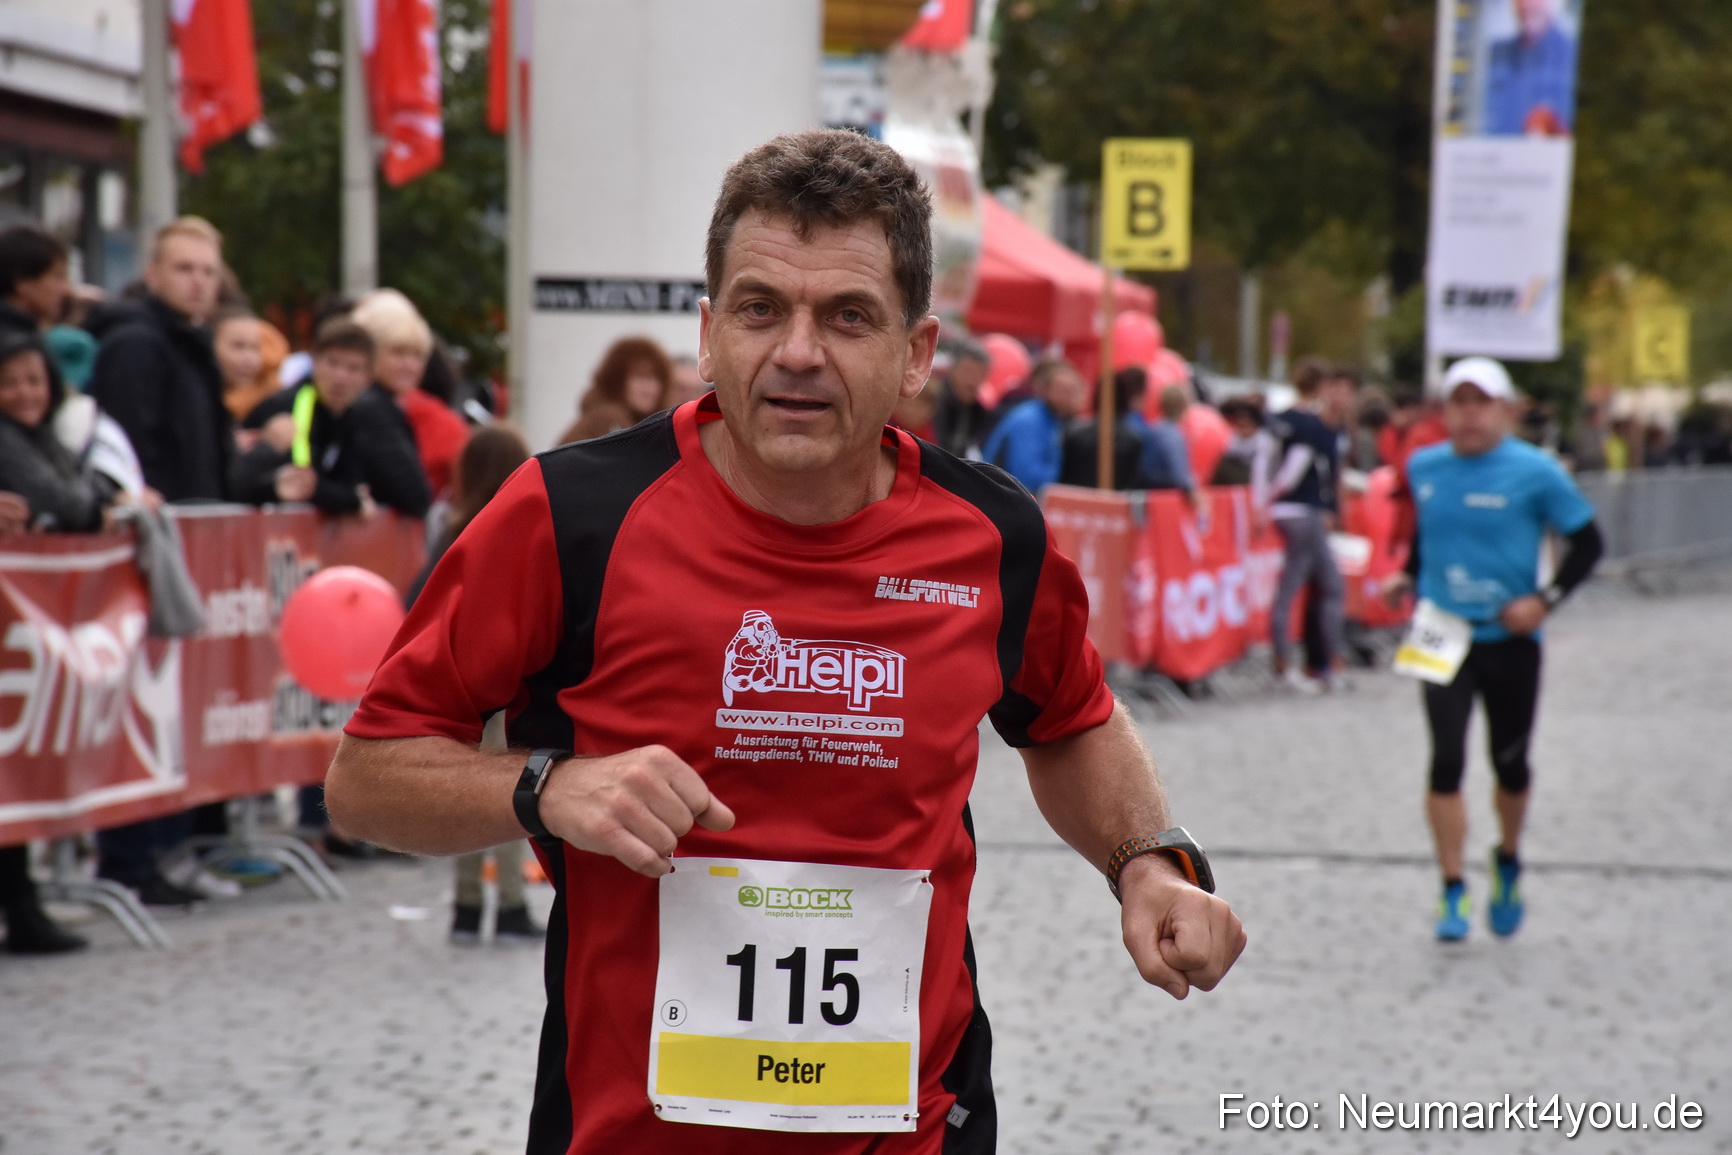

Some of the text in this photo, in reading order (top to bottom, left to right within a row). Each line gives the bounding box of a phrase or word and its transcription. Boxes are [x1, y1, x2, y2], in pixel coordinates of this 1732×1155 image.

[1127, 180, 1166, 238] B
[874, 575, 981, 609] BALLSPORTWELT
[775, 646, 902, 709] Helpi
[720, 712, 902, 733] www.helpi.com
[734, 733, 884, 755] Ausrüstung für Feuerwehr,
[714, 746, 899, 769] Rettungsdienst, THW und Polizei
[765, 887, 854, 910] BOCK
[764, 910, 854, 920] inspired by smart concepts
[726, 943, 860, 1027] 115
[668, 1006, 679, 1021] B
[757, 1054, 826, 1084] Peter
